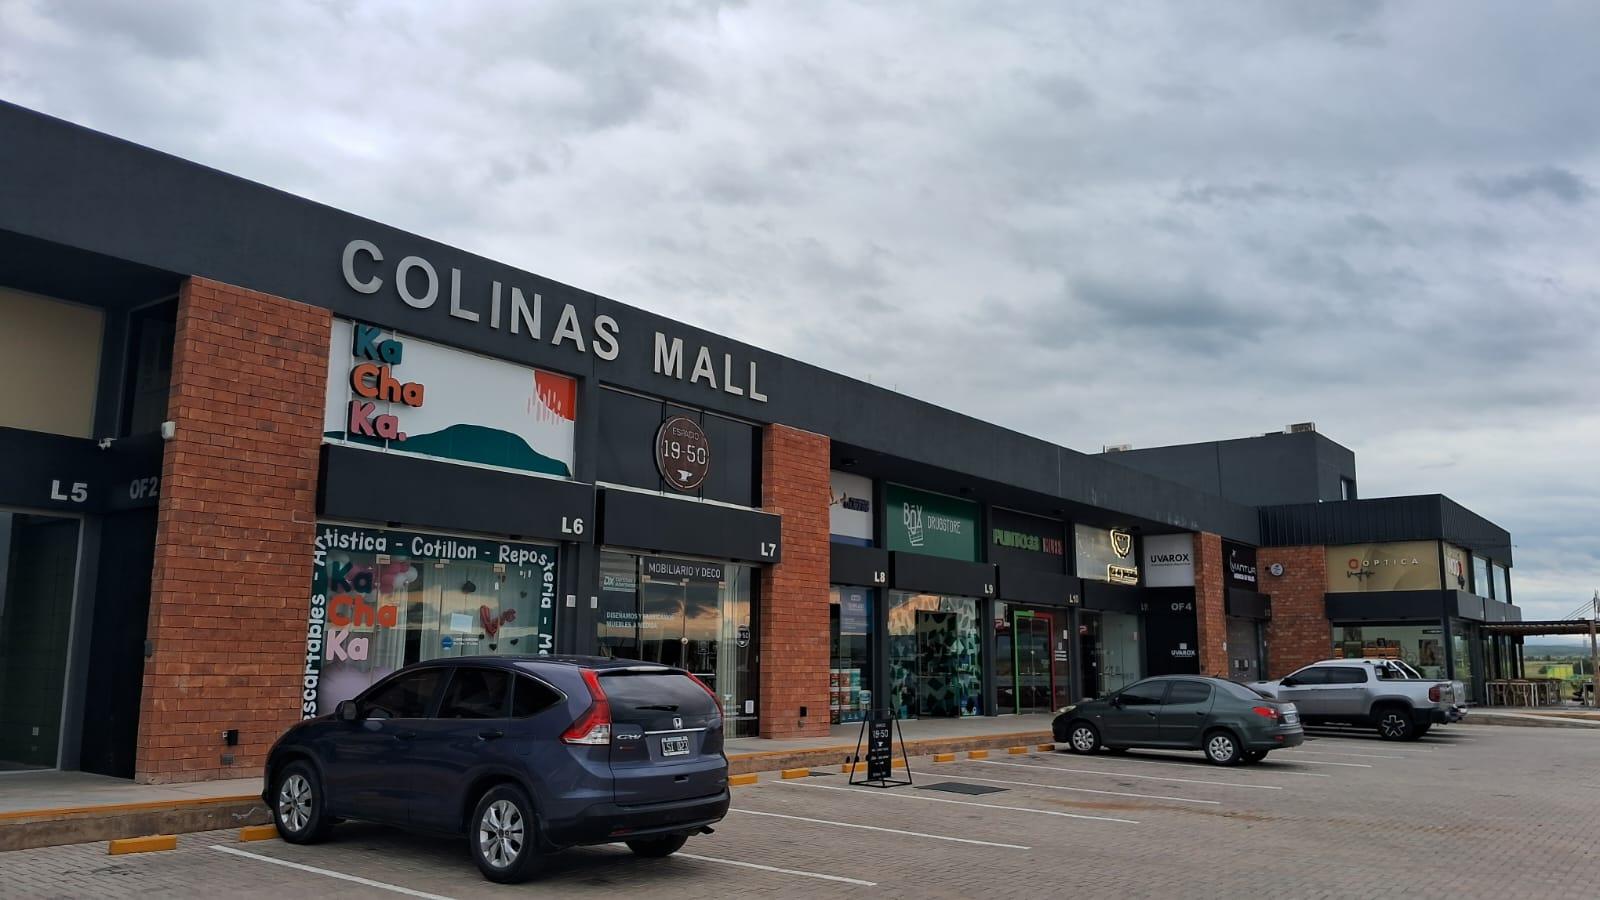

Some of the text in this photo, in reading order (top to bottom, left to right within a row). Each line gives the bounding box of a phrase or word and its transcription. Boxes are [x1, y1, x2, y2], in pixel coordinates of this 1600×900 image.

[342, 239, 768, 403] COLINAS MALL
[353, 323, 403, 365] Ka
[350, 363, 424, 407] Cha
[348, 400, 407, 441] Ka.
[672, 427, 699, 441] ESPACIO
[663, 439, 706, 465] 19-50
[51, 479, 88, 502] L5
[130, 477, 158, 500] OF2
[561, 516, 584, 535] L6
[927, 515, 961, 535] DRUGSTORE
[411, 536, 477, 560] Cotillon
[761, 541, 777, 558] L7
[1150, 552, 1190, 564] UVAROX
[648, 562, 721, 579] MOBILIARIO Y DECO
[1362, 558, 1419, 567] OPTICA
[330, 560, 374, 594] Ka
[874, 570, 886, 584] L8
[984, 583, 994, 595] L9
[327, 595, 398, 627] Cha
[1171, 602, 1192, 612] OF4
[325, 630, 369, 661] Ka
[1171, 649, 1195, 657] UVAROX
